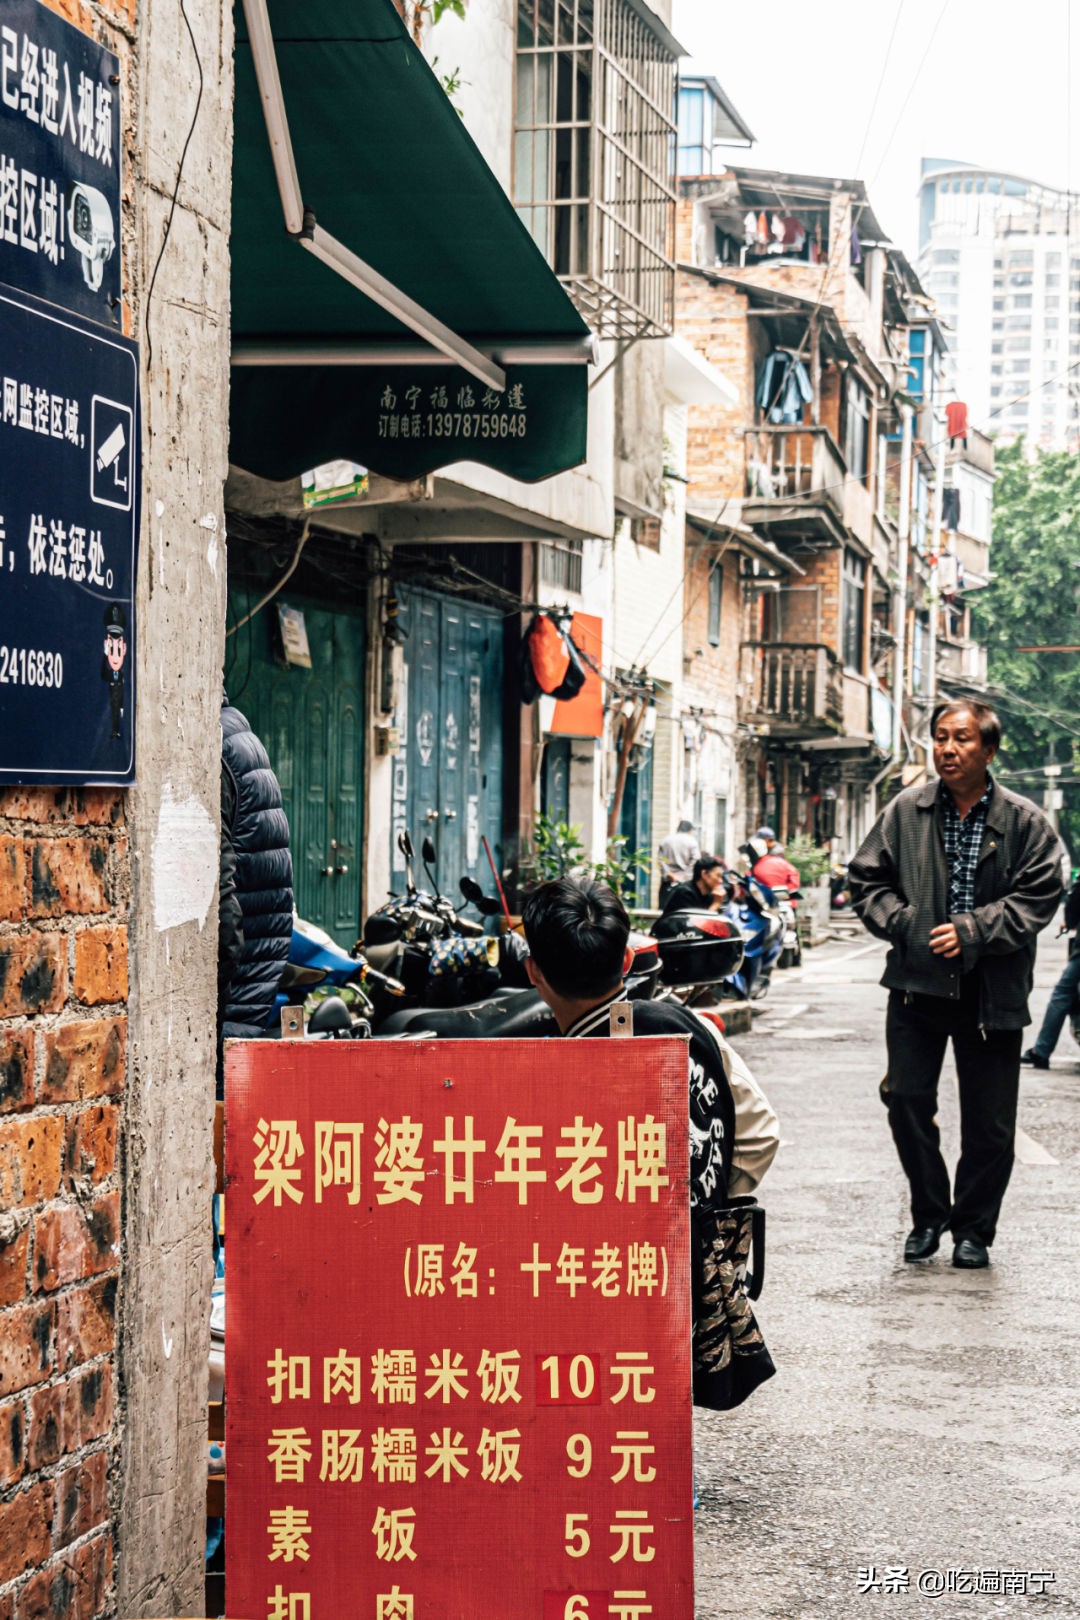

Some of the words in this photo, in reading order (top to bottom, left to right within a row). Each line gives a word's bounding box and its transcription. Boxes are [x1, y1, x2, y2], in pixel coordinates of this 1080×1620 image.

[2, 25, 112, 168] 已经进入视频
[0, 376, 85, 449] 网监控区域，
[0, 645, 63, 689] 2416830
[252, 1114, 670, 1206] 梁阿婆廿年老牌
[266, 1348, 523, 1405] 扣肉糯米饭
[266, 1427, 523, 1484] 香肠糯米饭
